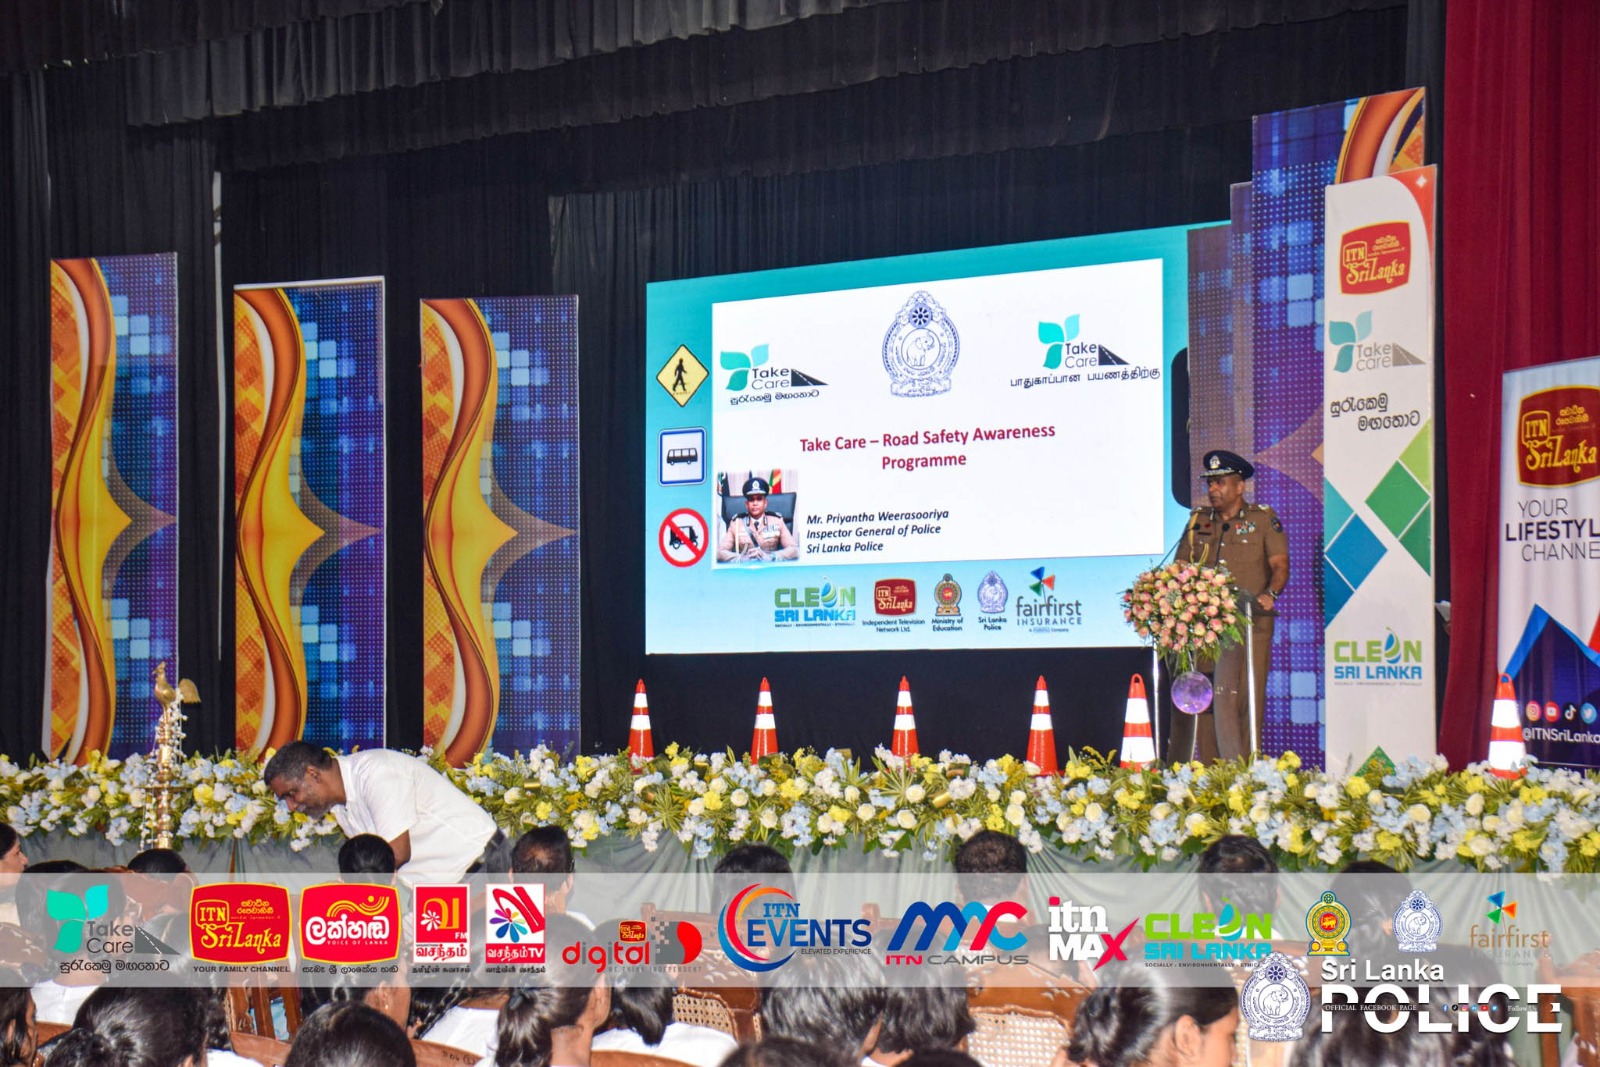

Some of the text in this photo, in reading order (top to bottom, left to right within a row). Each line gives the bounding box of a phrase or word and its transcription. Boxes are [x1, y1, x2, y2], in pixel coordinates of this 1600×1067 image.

[1345, 246, 1366, 263] ITN
[1065, 342, 1097, 355] Take
[1356, 342, 1392, 358] Take
[1065, 356, 1097, 369] Care
[752, 366, 790, 378] Take
[751, 378, 790, 390] Care
[1524, 418, 1548, 439] ITN
[800, 437, 831, 452] Take
[835, 435, 867, 450] Care
[883, 431, 919, 447] Road
[923, 428, 969, 445] Safety
[972, 425, 1056, 442] Awareness
[882, 453, 967, 472] Programme
[1518, 498, 1568, 518] YOUR
[806, 509, 949, 526] Mr. Priyantha Weerasooriya
[806, 524, 941, 542] Inspector General of Police
[1505, 518, 1600, 542] LIFESTYL
[806, 541, 884, 554] Sri Lanka Police
[1521, 541, 1600, 562] CHANNE
[1016, 595, 1082, 617] fairfirst
[774, 608, 856, 623] SRI LANKA
[862, 619, 897, 627] Independent
[898, 618, 925, 626] Television
[931, 618, 955, 626] Ministry
[1017, 617, 1082, 626] INSURANCE
[1334, 665, 1422, 680] SRI LANKA
